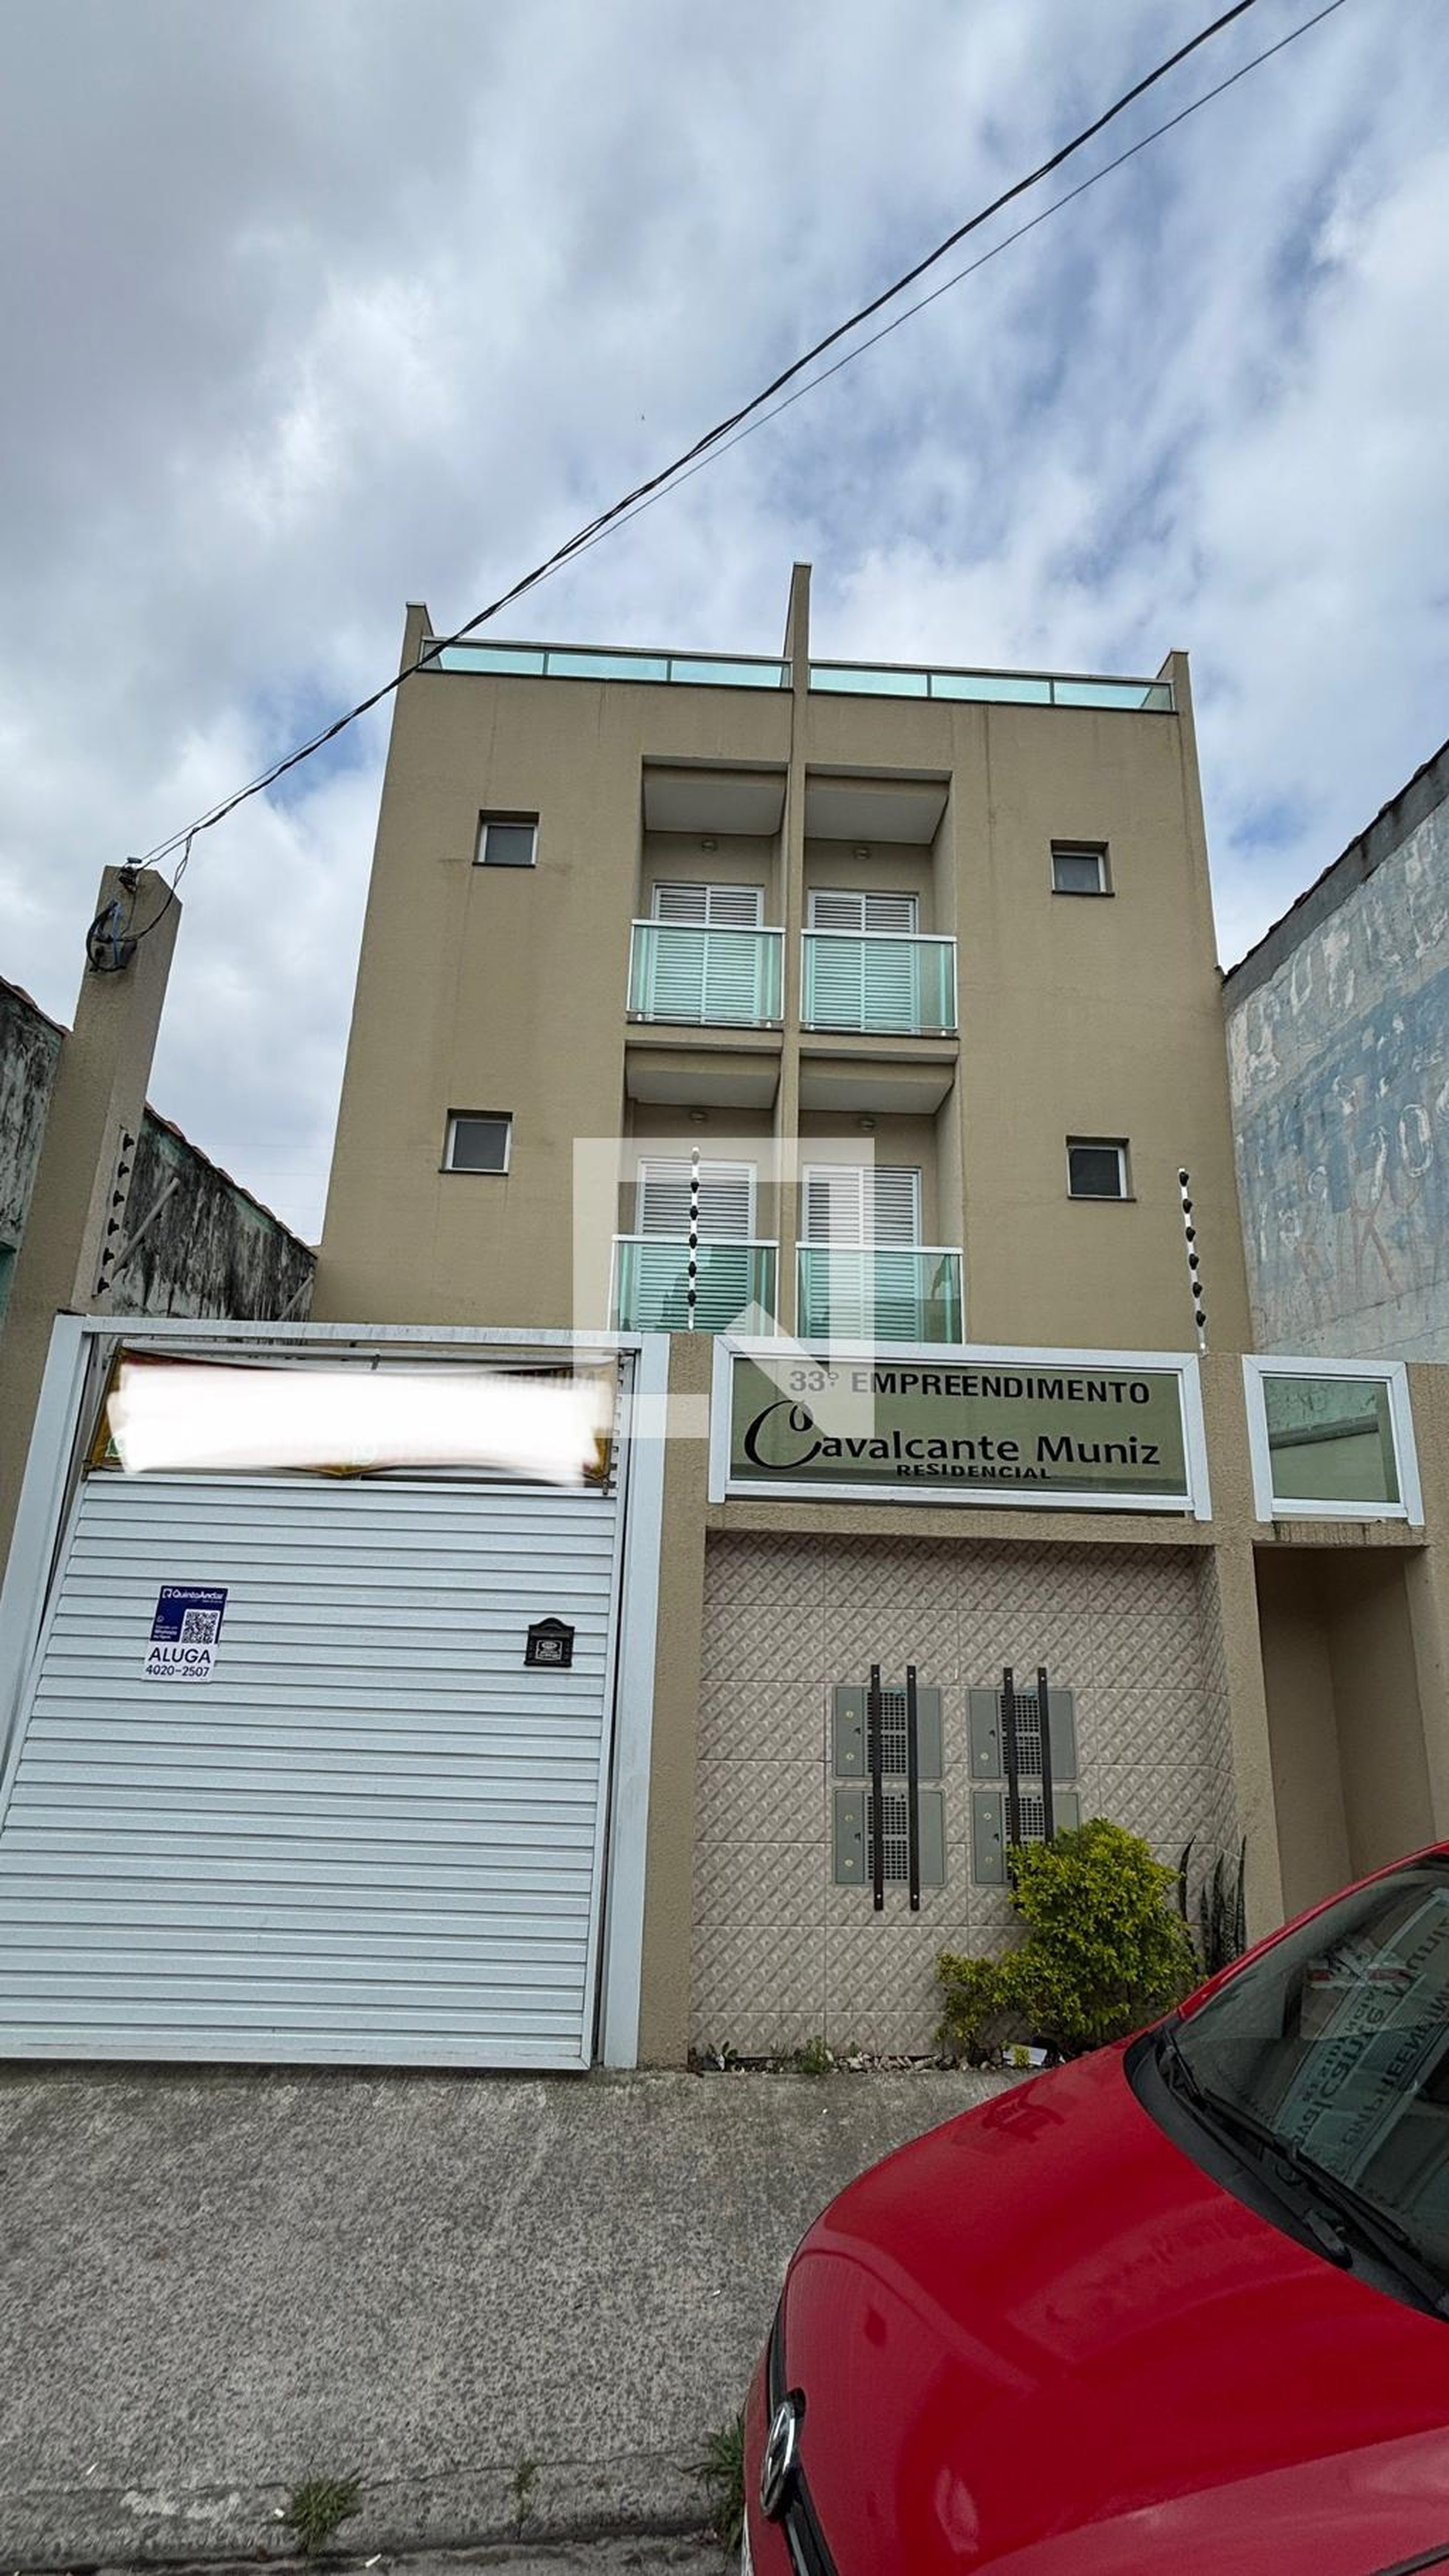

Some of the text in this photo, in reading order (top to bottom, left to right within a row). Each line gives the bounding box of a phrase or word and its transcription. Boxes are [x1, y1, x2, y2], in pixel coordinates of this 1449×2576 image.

[852, 1372, 1149, 1404] EMPREENDIMENTO
[744, 1400, 1160, 1469] Cavalcante Muniz
[897, 1463, 1052, 1480] RESIDENCIAL
[148, 1648, 211, 1663] ALUGA
[146, 1665, 209, 1677] 4020-2507
